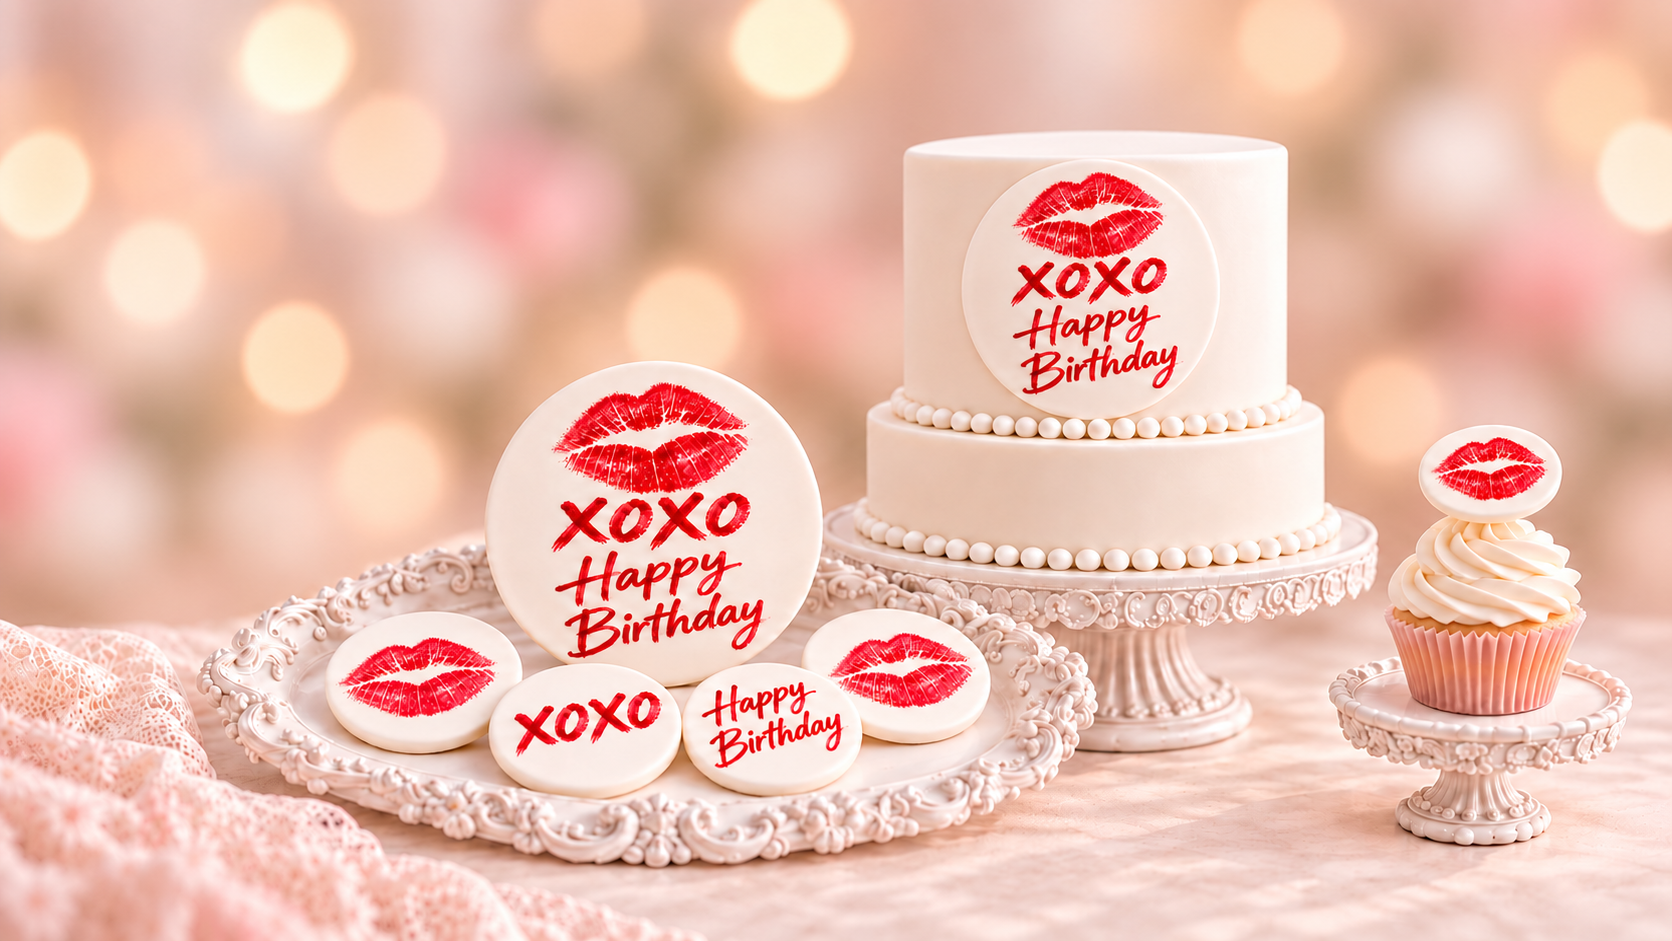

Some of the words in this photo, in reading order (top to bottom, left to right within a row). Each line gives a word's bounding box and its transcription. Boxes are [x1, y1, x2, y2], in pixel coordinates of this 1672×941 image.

[1011, 257, 1167, 306] XOXO
[1013, 305, 1161, 350] Happy
[1020, 340, 1179, 394] Birthday
[551, 492, 751, 552] XOXO
[555, 551, 742, 606] Happy
[564, 592, 765, 658] Birthday
[514, 691, 661, 757] XOXO
[702, 682, 817, 726] Happy
[710, 711, 845, 768] Birthday
